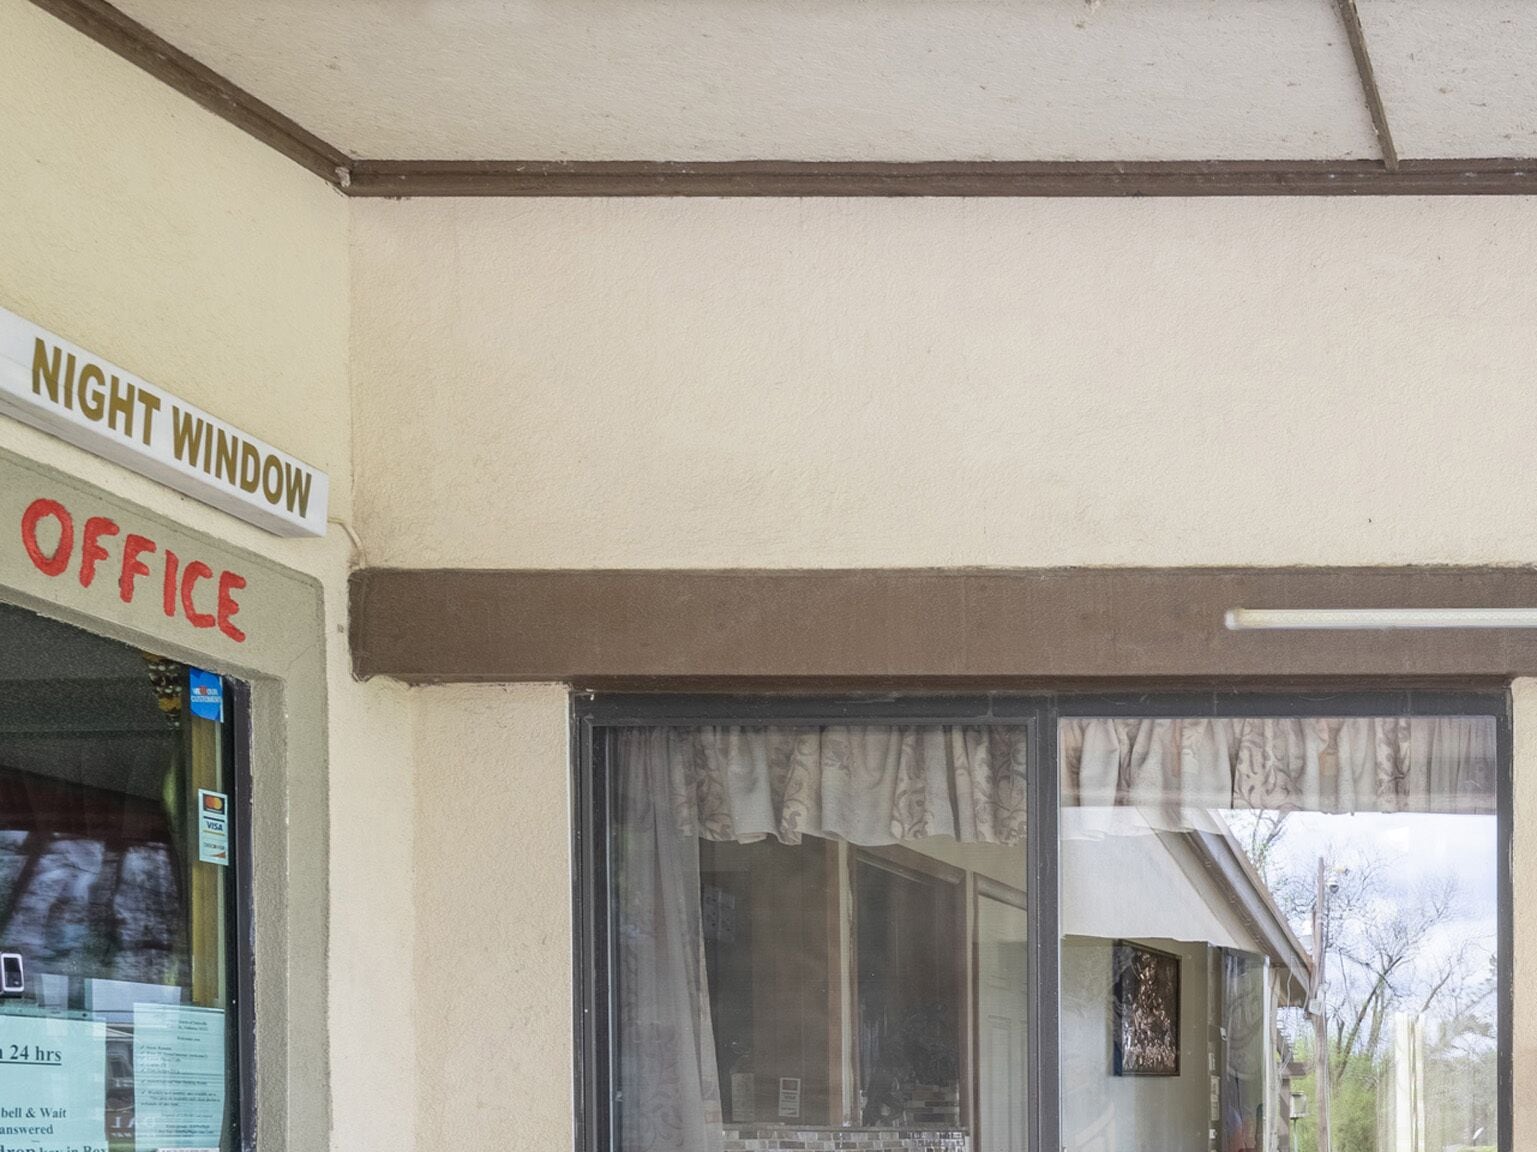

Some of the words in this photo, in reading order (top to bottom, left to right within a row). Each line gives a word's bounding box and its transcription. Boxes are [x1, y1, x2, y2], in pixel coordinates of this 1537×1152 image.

[32, 337, 161, 446] NIGHT
[172, 405, 312, 518] WINDOW
[21, 498, 246, 642] OFFICE
[206, 821, 224, 832] VISA
[10, 1044, 29, 1060] 24
[35, 1046, 62, 1061] hrs
[1, 1107, 22, 1118] bell
[25, 1107, 36, 1118] &
[40, 1107, 66, 1118] Wait
[0, 1124, 54, 1135] answered
